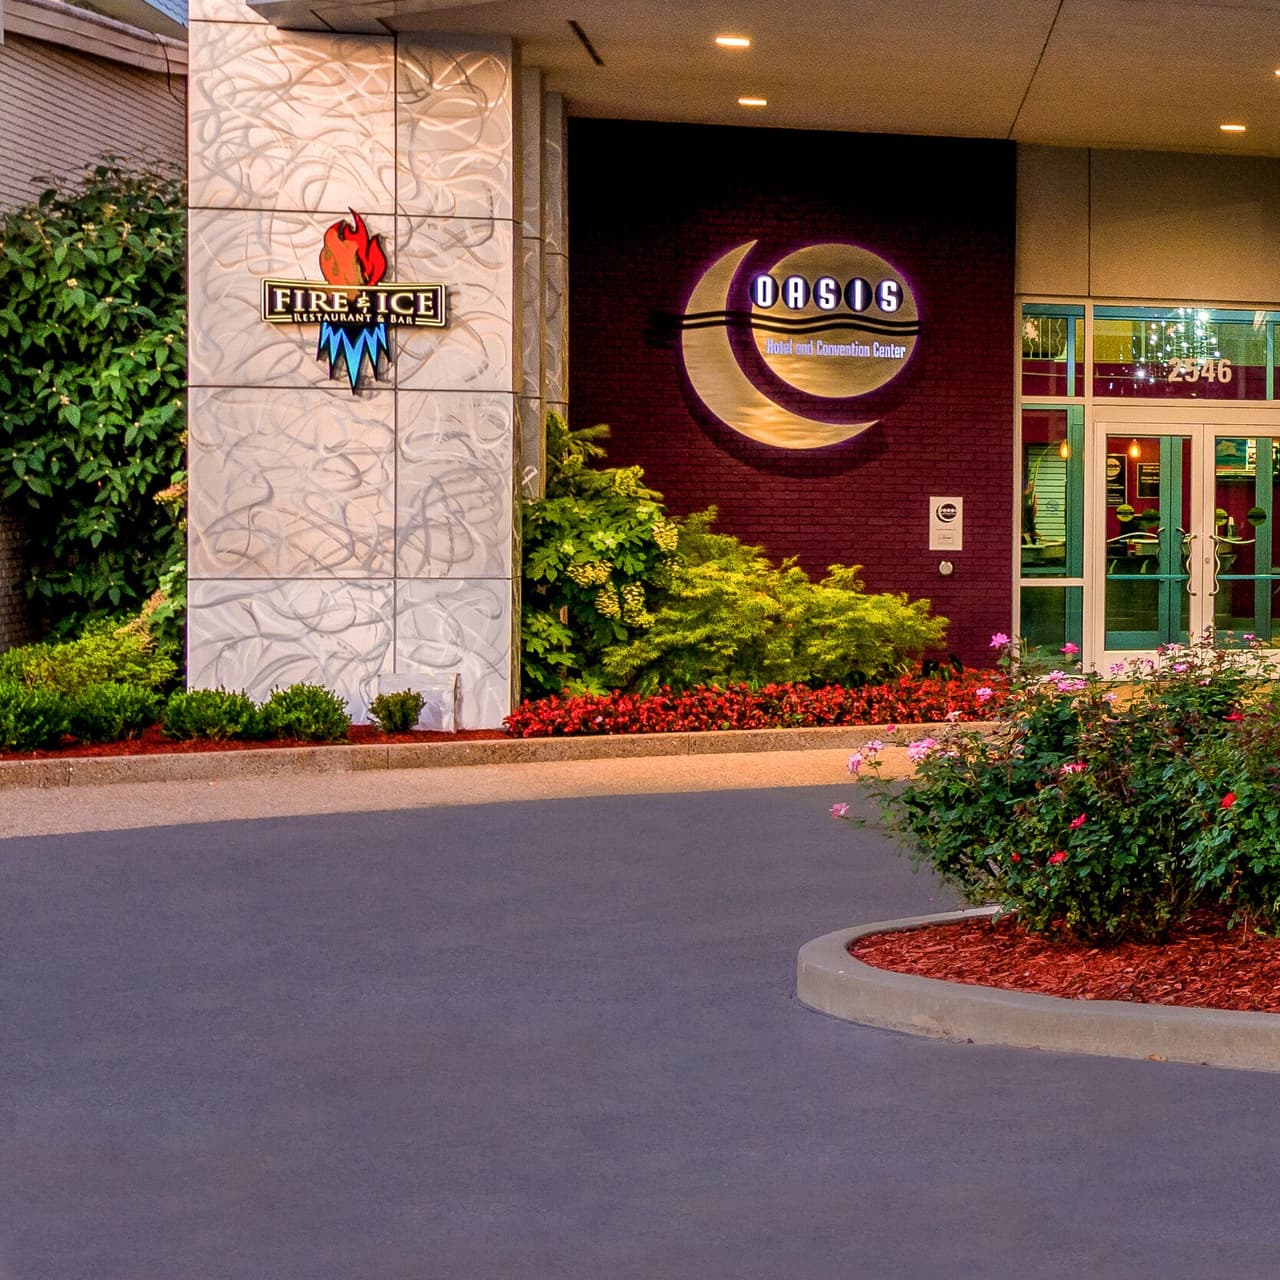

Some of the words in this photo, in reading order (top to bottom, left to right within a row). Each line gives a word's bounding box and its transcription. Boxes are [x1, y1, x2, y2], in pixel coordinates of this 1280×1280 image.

[273, 287, 349, 312] FIRE
[356, 291, 371, 314] &
[377, 292, 434, 316] ICE
[755, 275, 898, 312] OASIS
[293, 313, 372, 323] RESTAURANT
[377, 314, 385, 323] &
[390, 315, 413, 325] BAR
[766, 338, 793, 355] Hotel
[795, 340, 813, 356] and
[816, 339, 870, 358] Convention
[873, 341, 906, 359] Center
[1168, 357, 1232, 384] 2546
